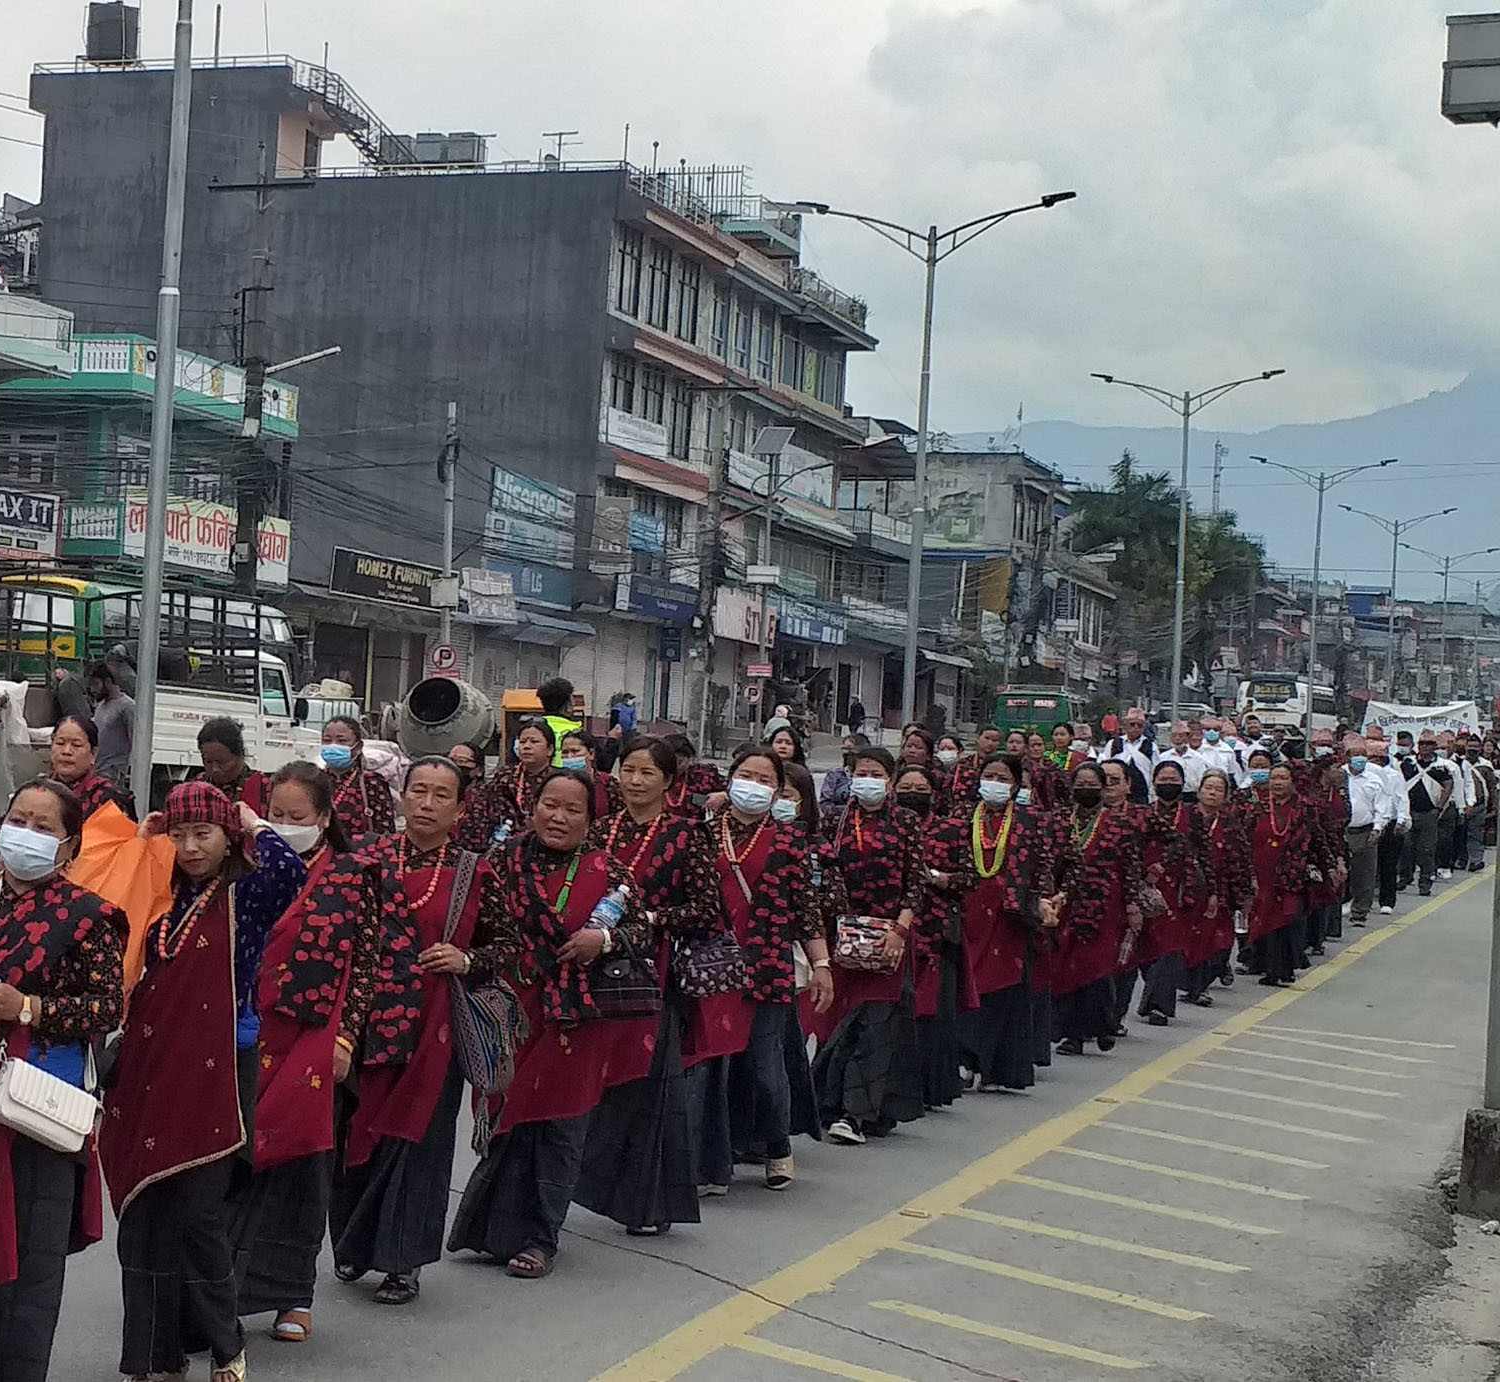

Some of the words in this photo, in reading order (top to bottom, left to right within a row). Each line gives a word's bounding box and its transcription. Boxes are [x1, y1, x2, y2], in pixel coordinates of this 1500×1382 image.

[28, 498, 53, 525] IT
[356, 557, 393, 580] HOMEX
[531, 573, 543, 593] LG
[745, 605, 775, 645] STE
